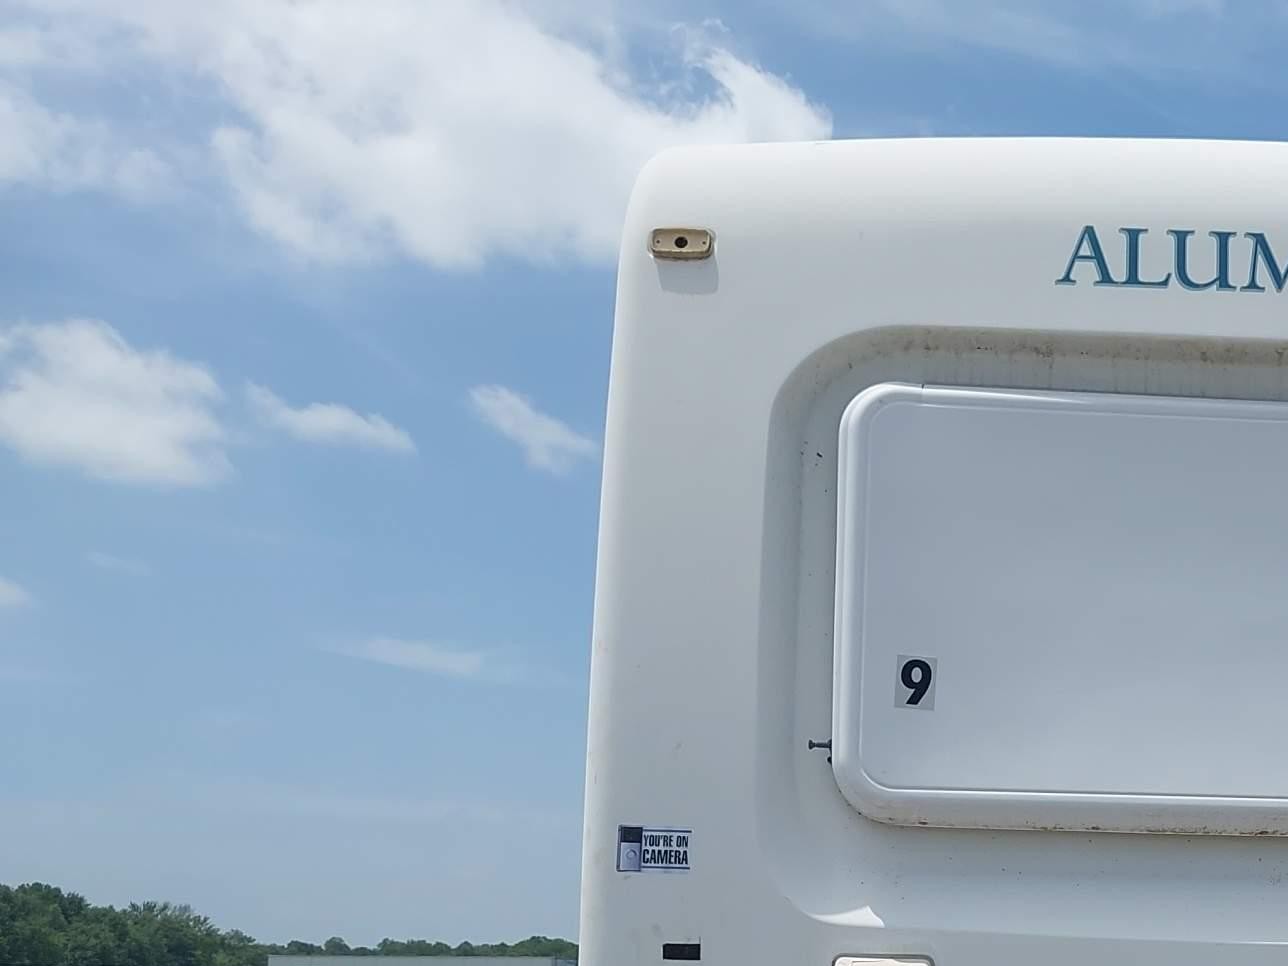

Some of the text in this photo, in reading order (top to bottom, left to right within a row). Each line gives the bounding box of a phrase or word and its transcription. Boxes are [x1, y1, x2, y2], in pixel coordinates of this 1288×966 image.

[900, 659, 932, 706] 9
[643, 834, 689, 848] YOU'RE ON
[642, 848, 689, 865] CAMERA
